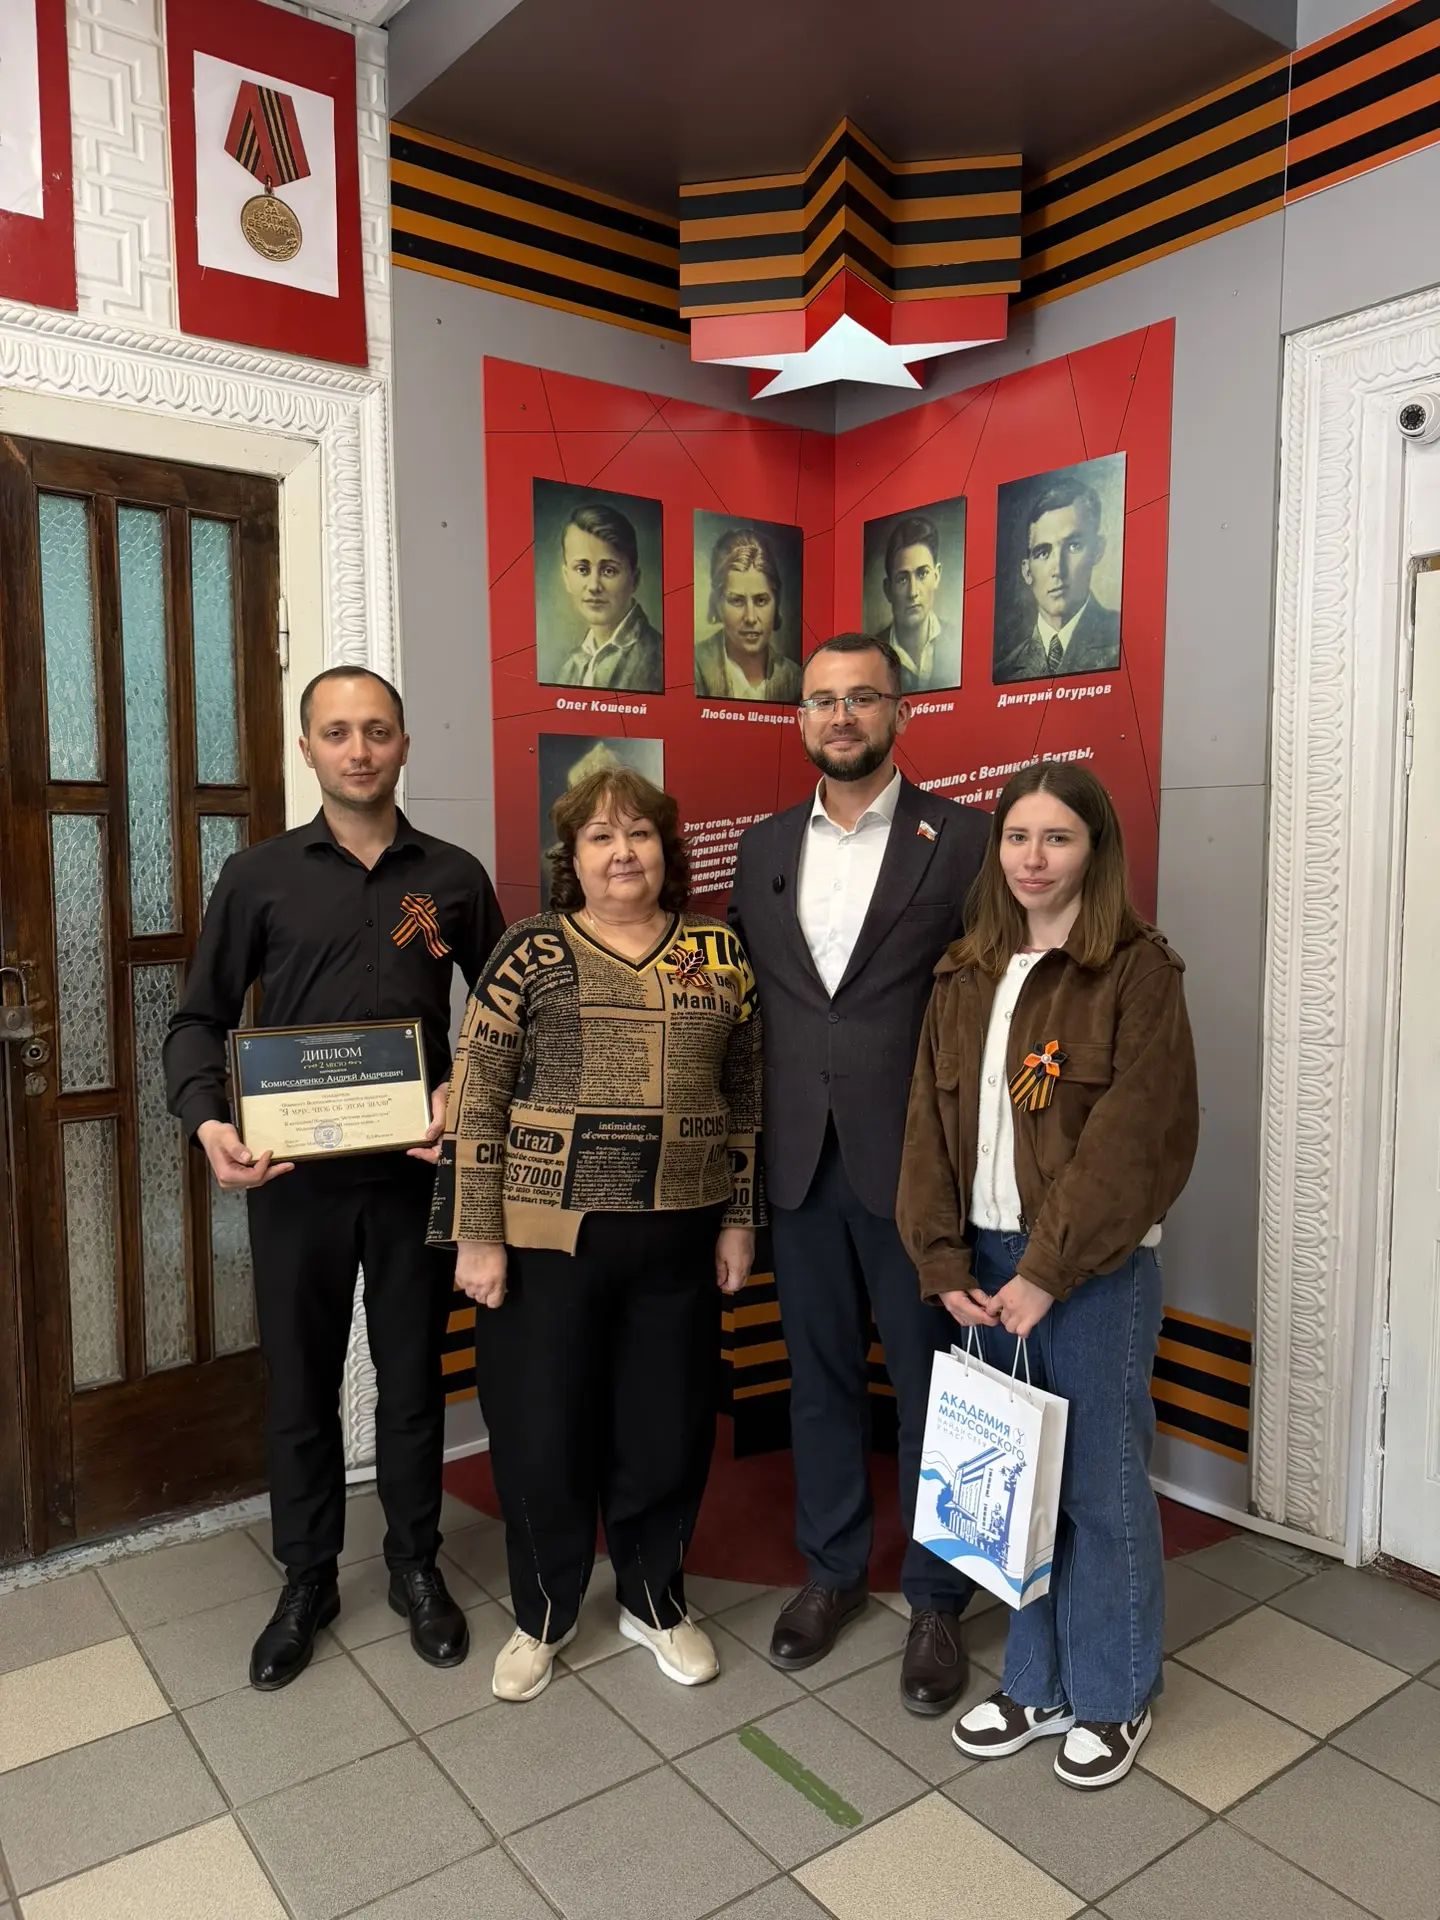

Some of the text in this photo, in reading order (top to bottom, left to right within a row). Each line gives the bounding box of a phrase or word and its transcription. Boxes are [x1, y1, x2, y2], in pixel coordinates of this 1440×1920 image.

[253, 211, 289, 228] ВЗЯТИЕ
[265, 206, 279, 216] ЗА
[247, 219, 296, 238] БЕРЛИНА
[997, 684, 1112, 708] Дмитрий Огурцов
[556, 698, 647, 715] Олег Кошевой
[910, 702, 955, 718] убботин
[701, 708, 795, 725] Любовь Шевцова
[969, 769, 977, 782] с
[950, 787, 983, 805] ятой
[683, 821, 706, 833] Этот
[706, 817, 734, 830] огонь,
[735, 813, 753, 826] как
[691, 842, 740, 859] признател
[672, 991, 717, 1011] Mani
[475, 1020, 520, 1049] Mani
[300, 1046, 363, 1064] ДИПЛОМ
[319, 1061, 325, 1069] 2
[599, 1121, 647, 1132] intimidate
[679, 1115, 725, 1139] CIRCUS
[517, 1128, 555, 1152] Frazi
[476, 1143, 504, 1165] CIR
[940, 1391, 1011, 1438] АКАДЕМИЯ
[938, 1404, 1025, 1461] МАТУСОВСКОГО
